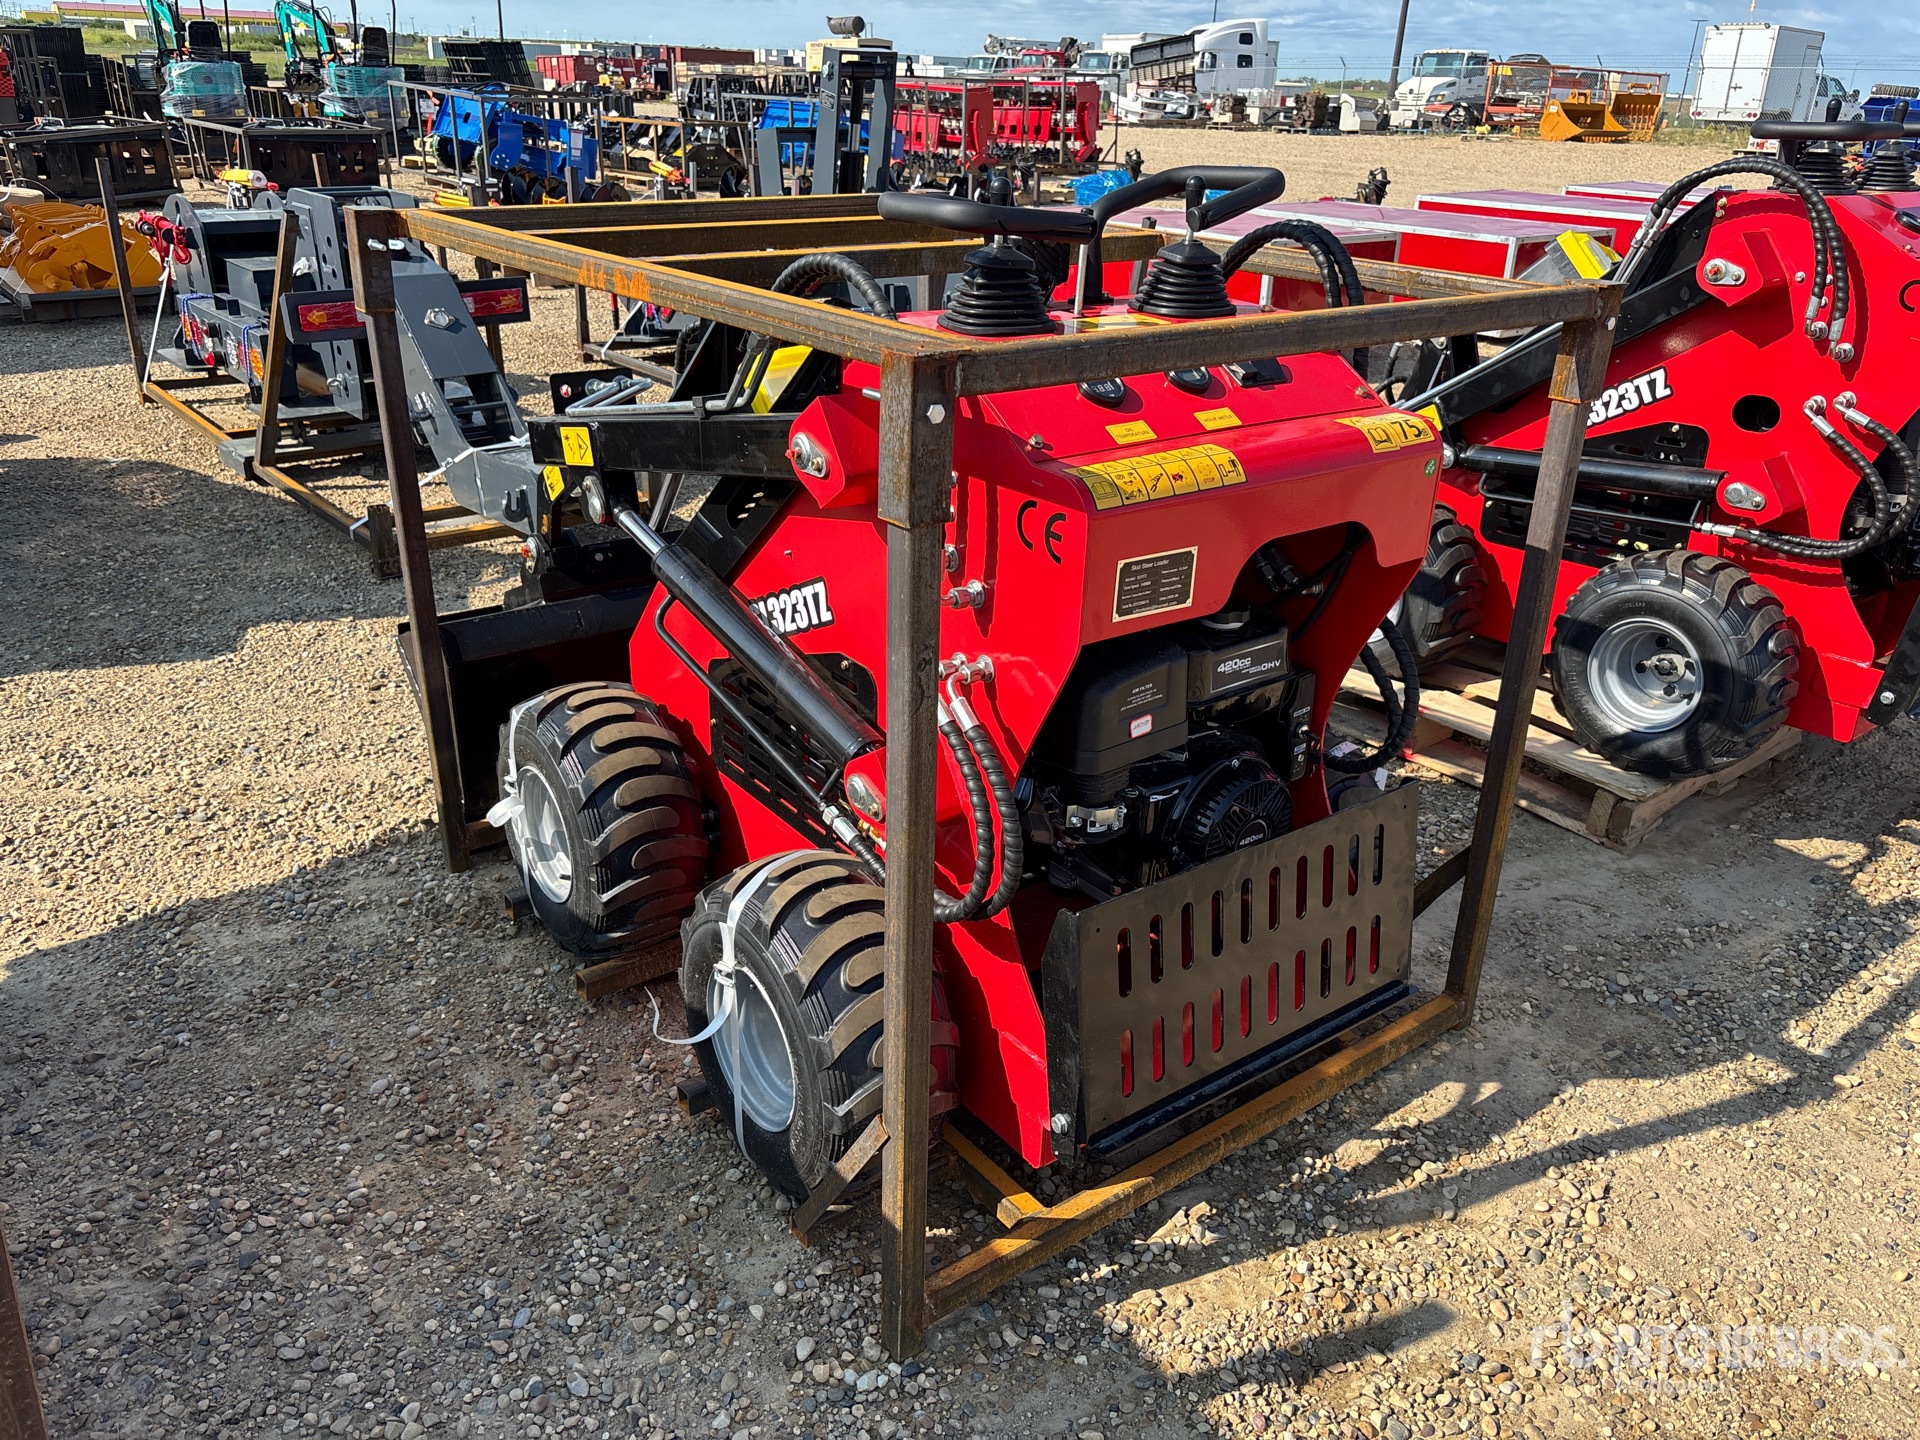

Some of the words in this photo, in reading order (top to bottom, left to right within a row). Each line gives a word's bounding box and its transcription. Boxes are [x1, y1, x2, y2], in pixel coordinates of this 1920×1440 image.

[1587, 368, 1671, 426] 323TZ
[1116, 430, 1151, 440] TEMPERATURE
[1391, 420, 1422, 440] 75
[1017, 500, 1066, 565] CE
[1131, 563, 1141, 572] Skid
[1142, 562, 1154, 570] Steer
[1154, 559, 1170, 567] Loader
[1217, 657, 1252, 673] 420cc
[1261, 659, 1281, 671] OHV
[1240, 833, 1264, 845] 420cc
